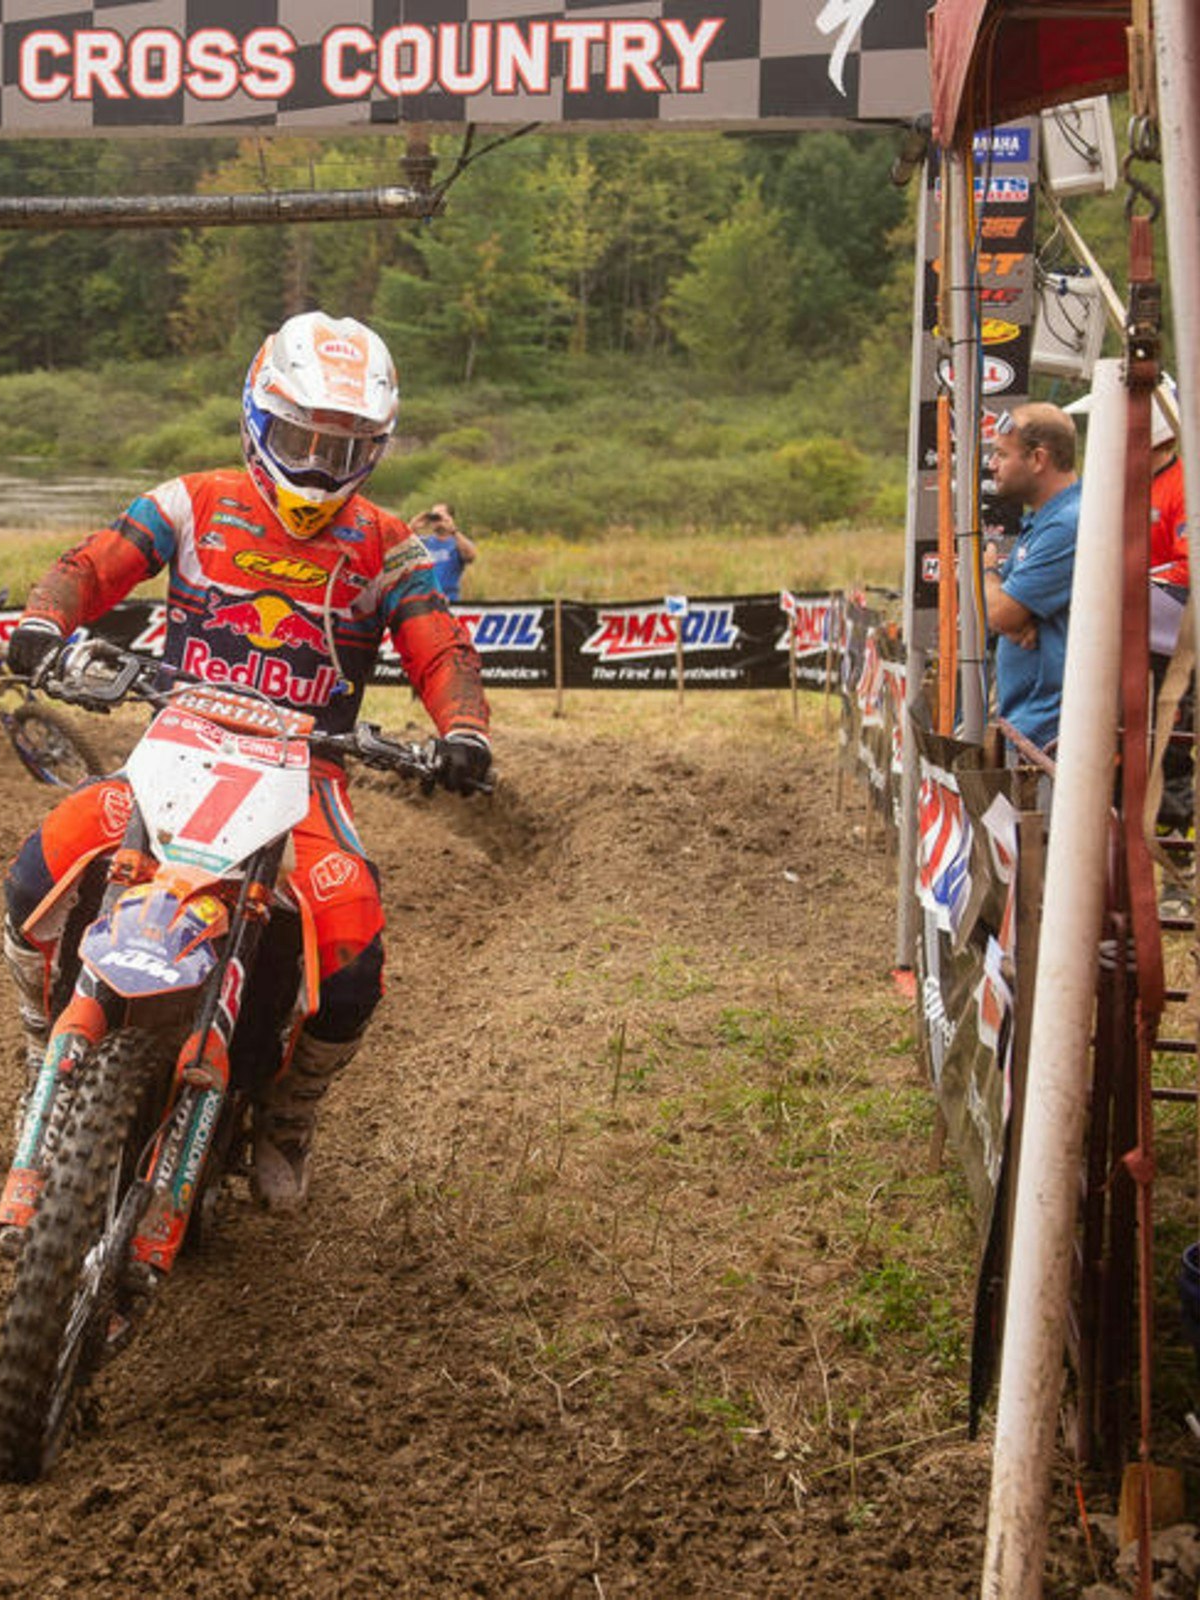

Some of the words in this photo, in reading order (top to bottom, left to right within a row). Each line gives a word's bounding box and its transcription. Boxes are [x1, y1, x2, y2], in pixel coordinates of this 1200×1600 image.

[18, 27, 295, 101] CROSS
[321, 17, 725, 97] COUNTRY
[588, 606, 736, 656] AMSOIL
[182, 637, 261, 687] Red
[260, 656, 337, 706] Bull
[592, 667, 617, 680] The
[618, 666, 651, 680] First
[653, 666, 667, 680] in
[175, 692, 300, 737] RENTHAL
[178, 761, 265, 846] 1
[183, 1089, 221, 1182] MOTOREX
